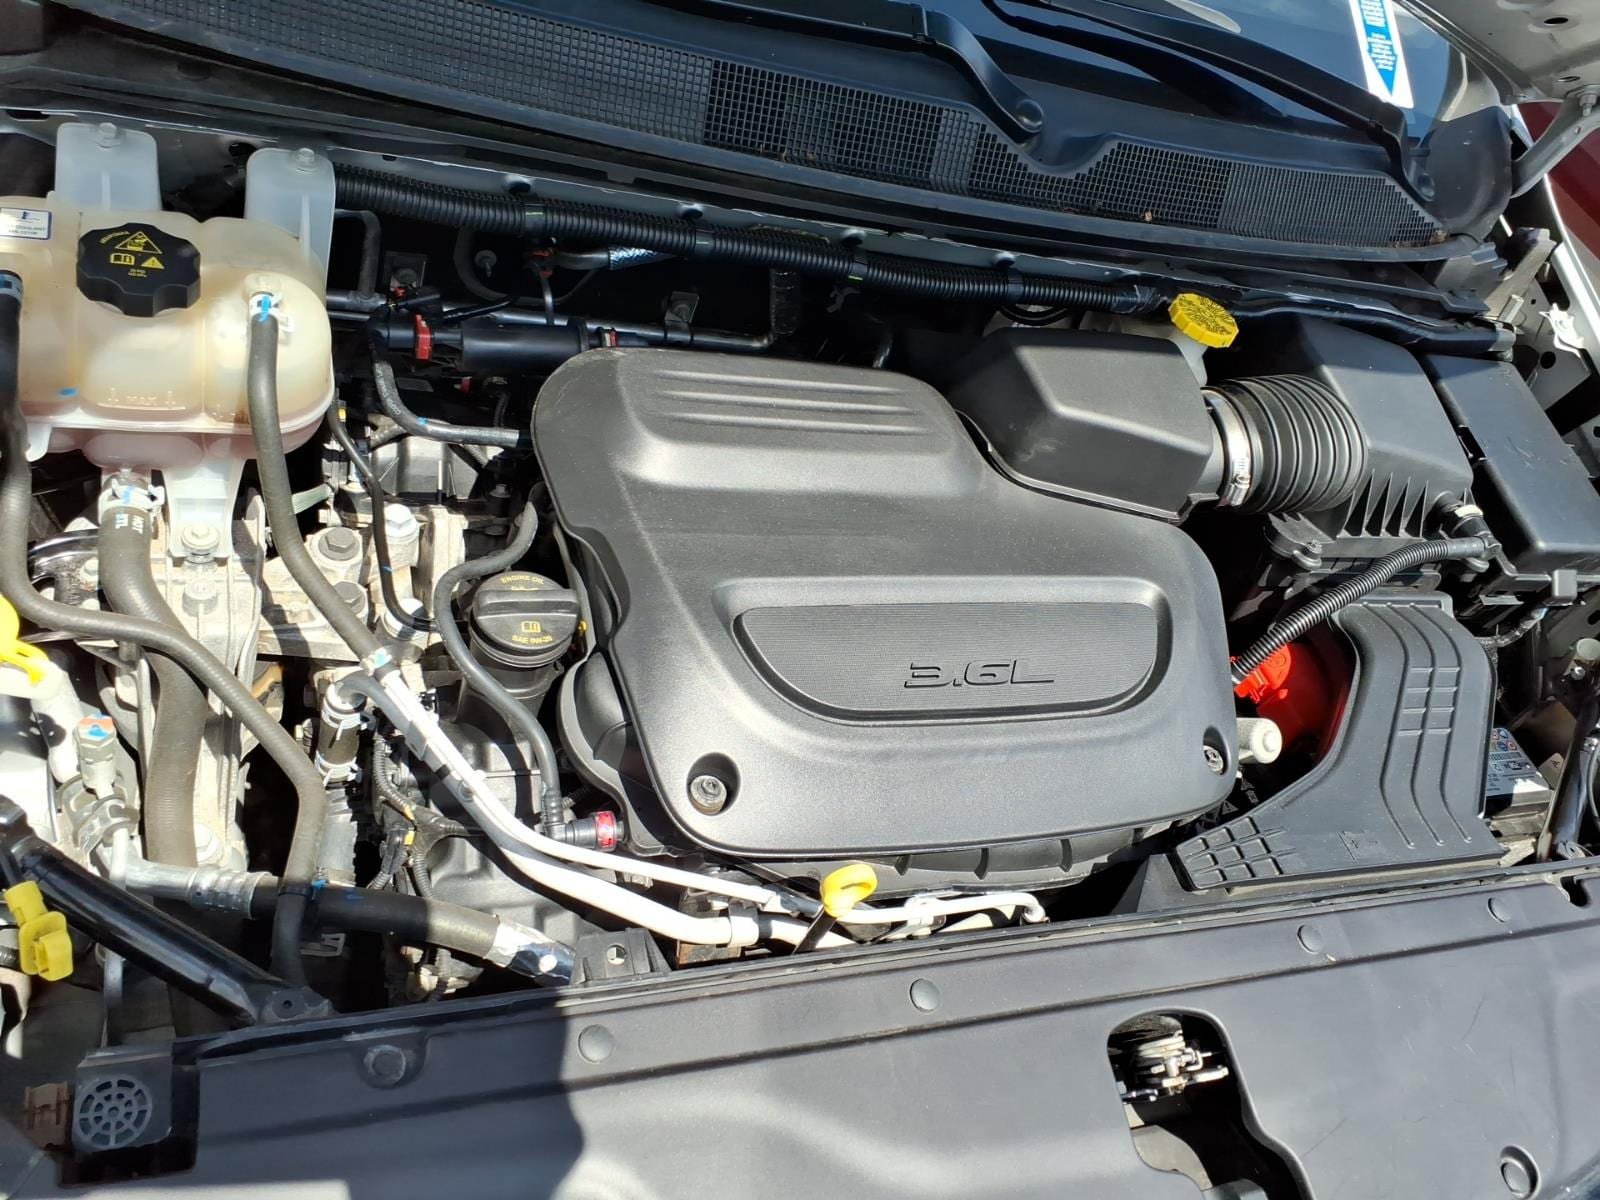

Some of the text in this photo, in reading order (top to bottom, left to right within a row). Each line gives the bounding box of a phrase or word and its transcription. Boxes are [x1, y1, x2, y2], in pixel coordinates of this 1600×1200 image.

[132, 515, 144, 535] HOT
[500, 575, 530, 584] ENGINE
[511, 635, 553, 645] SAE 0W-20
[904, 659, 1055, 688] 3.6L
